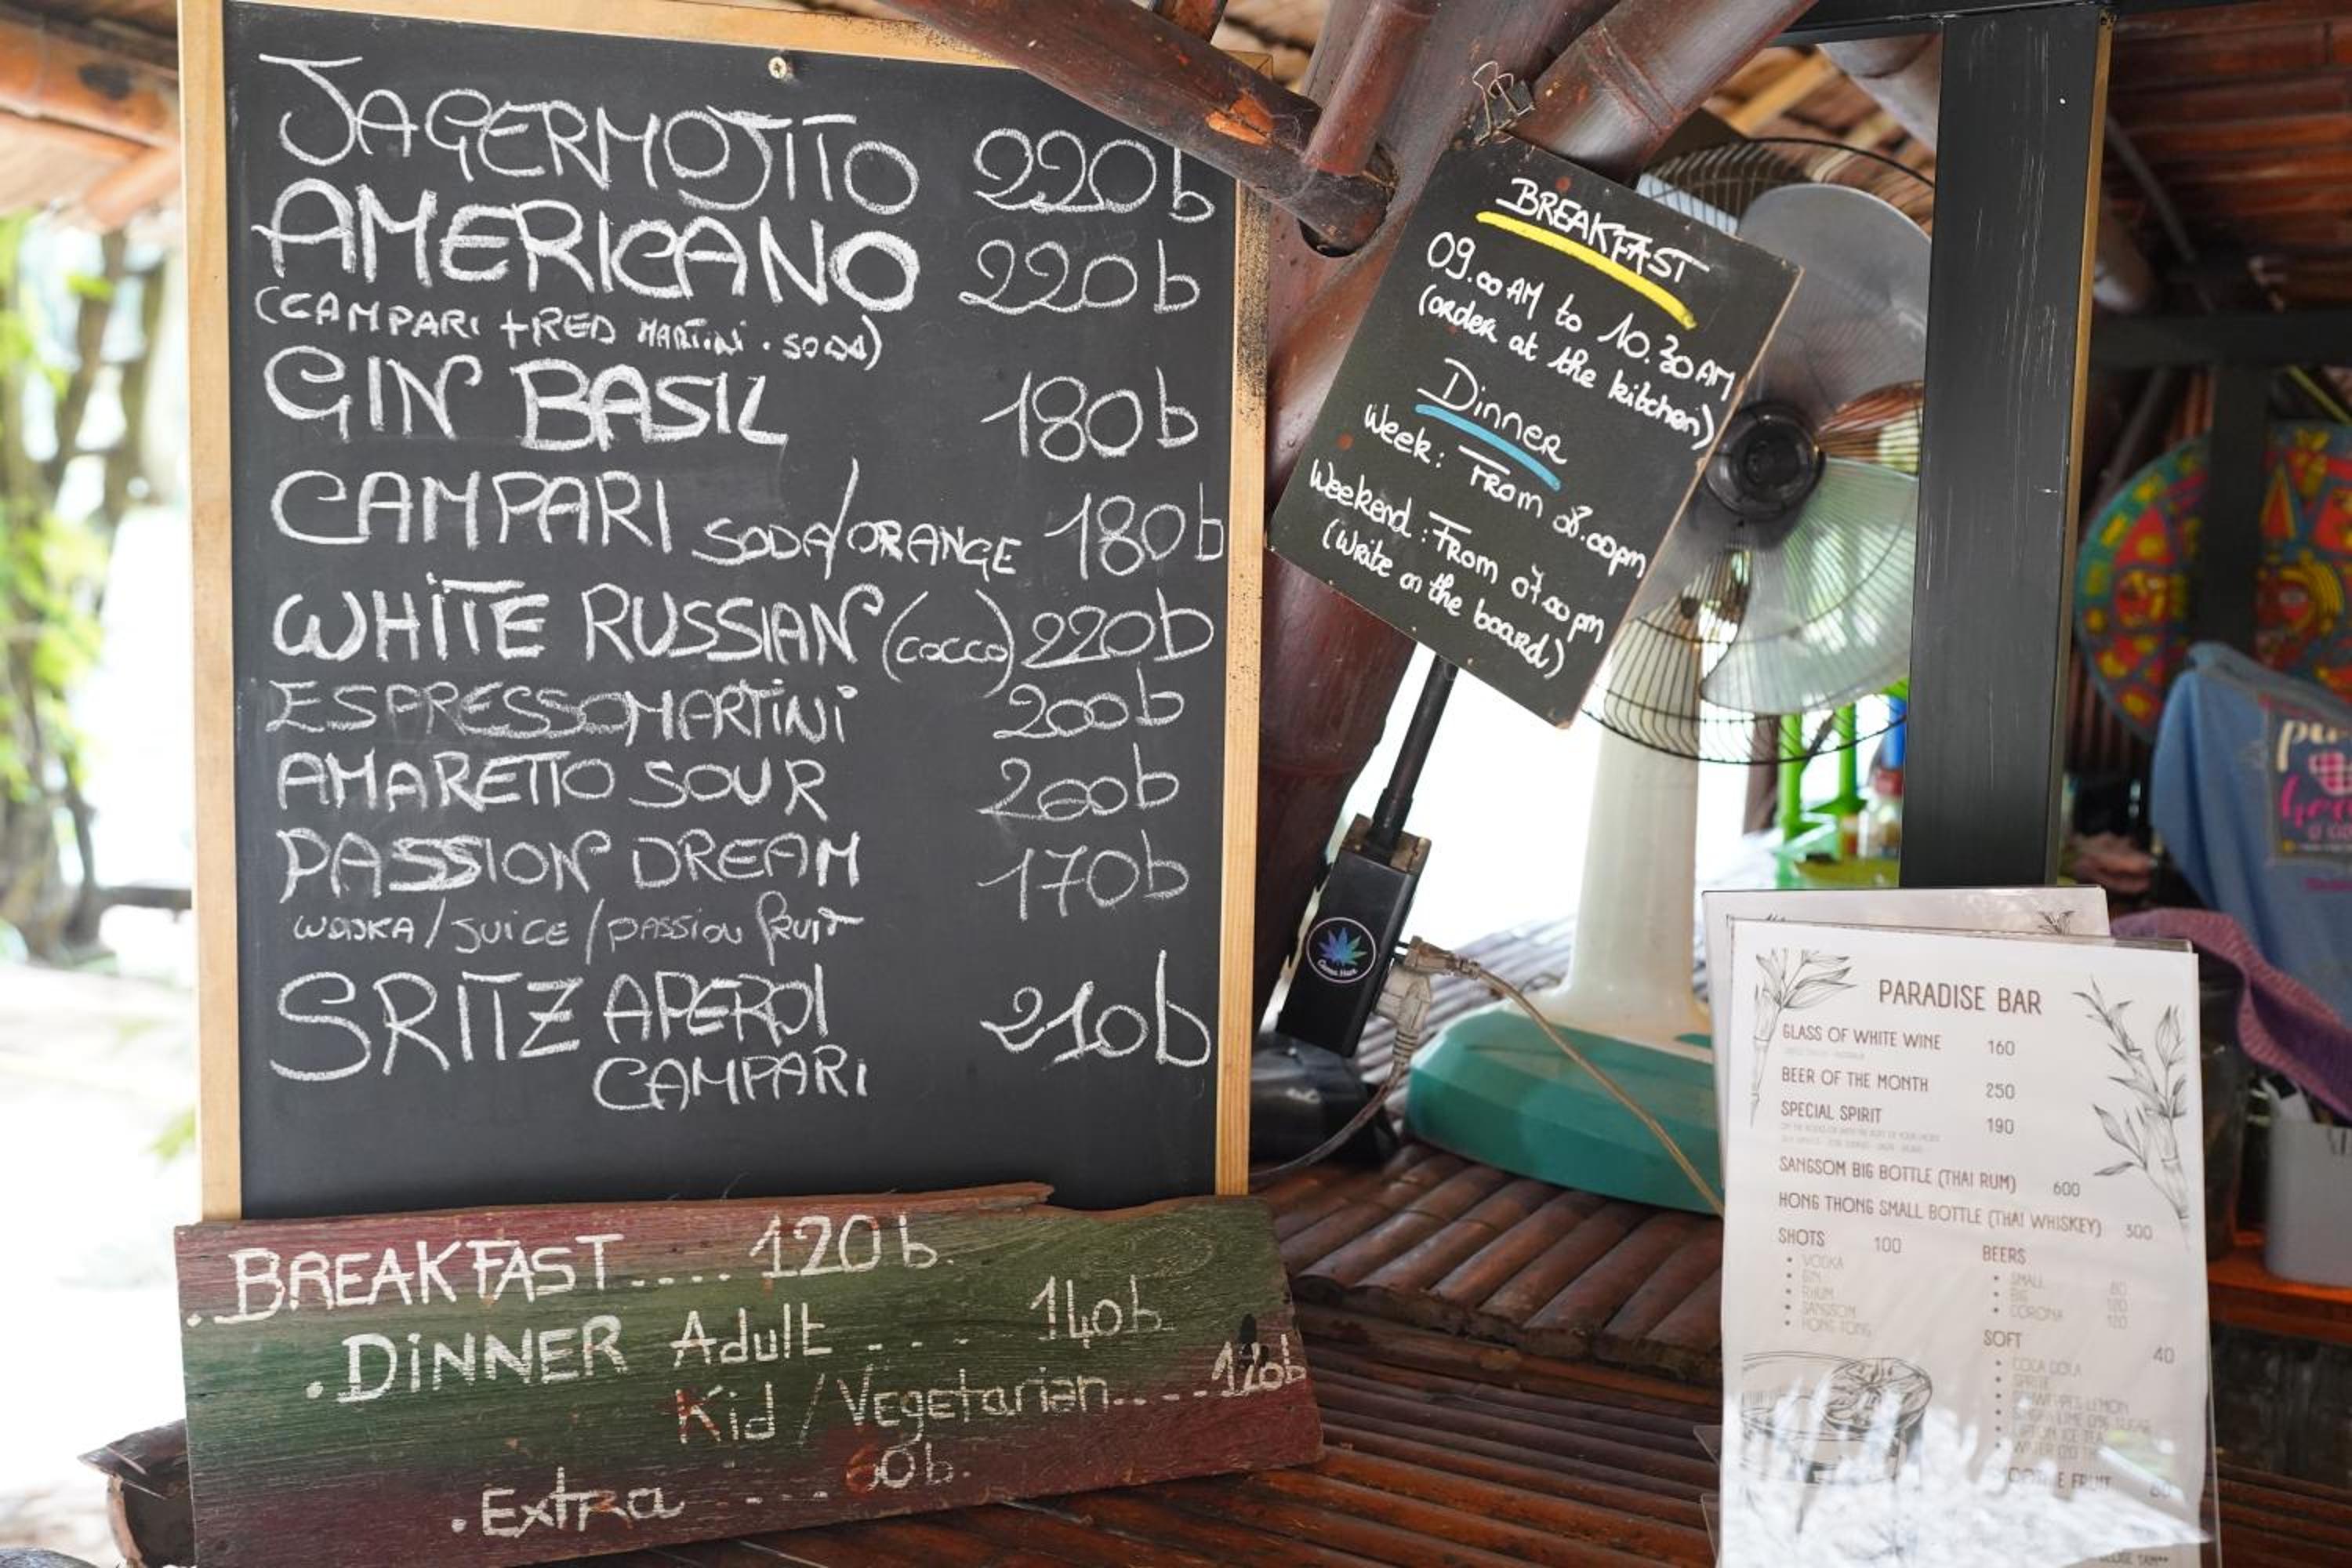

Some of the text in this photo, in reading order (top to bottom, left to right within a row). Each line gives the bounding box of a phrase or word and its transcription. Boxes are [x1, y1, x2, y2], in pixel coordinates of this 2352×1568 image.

[252, 178, 921, 312] AMERICANO
[1495, 177, 1711, 283] BREAKFAST
[1555, 294, 1584, 332] to
[1508, 333, 1539, 362] at
[1547, 346, 1598, 389] the
[263, 345, 482, 442] GIN
[510, 358, 788, 452] BASIL
[270, 470, 672, 554] CAMPARI
[1427, 571, 1462, 617] the
[581, 583, 885, 664] RUSSIAN
[277, 747, 616, 812] AMARETTO
[629, 757, 829, 823] SOUR
[275, 828, 612, 904] PASSION
[632, 826, 862, 891] DREAM
[1878, 978, 2042, 1015] PARADISE BAR
[270, 971, 585, 1081] SRITZ
[1782, 1023, 2016, 1057] GLASS OF WHITE WINE 160
[1781, 1066, 2016, 1100] BEER OF THE MONTH 250
[1780, 1100, 2015, 1135] SPECIAL SPIRIT 190
[1779, 1156, 2082, 1198] SANGSOM BIG BOTTLE (THAI RUM) 600
[1778, 1192, 1821, 1213] HONG
[1824, 1195, 1875, 1217] THONG
[1878, 1199, 1924, 1221] SMALL
[1929, 1203, 1983, 1225] BOTTLE
[2030, 1213, 2103, 1237] WHISKEY)
[1778, 1228, 1902, 1254] SHOTS 100
[1982, 1245, 2027, 1265] BEERS
[670, 1302, 833, 1369] Adult
[1982, 1329, 2176, 1365] SOFT 40
[674, 1381, 776, 1446] Kid
[481, 1466, 685, 1539] Extra
